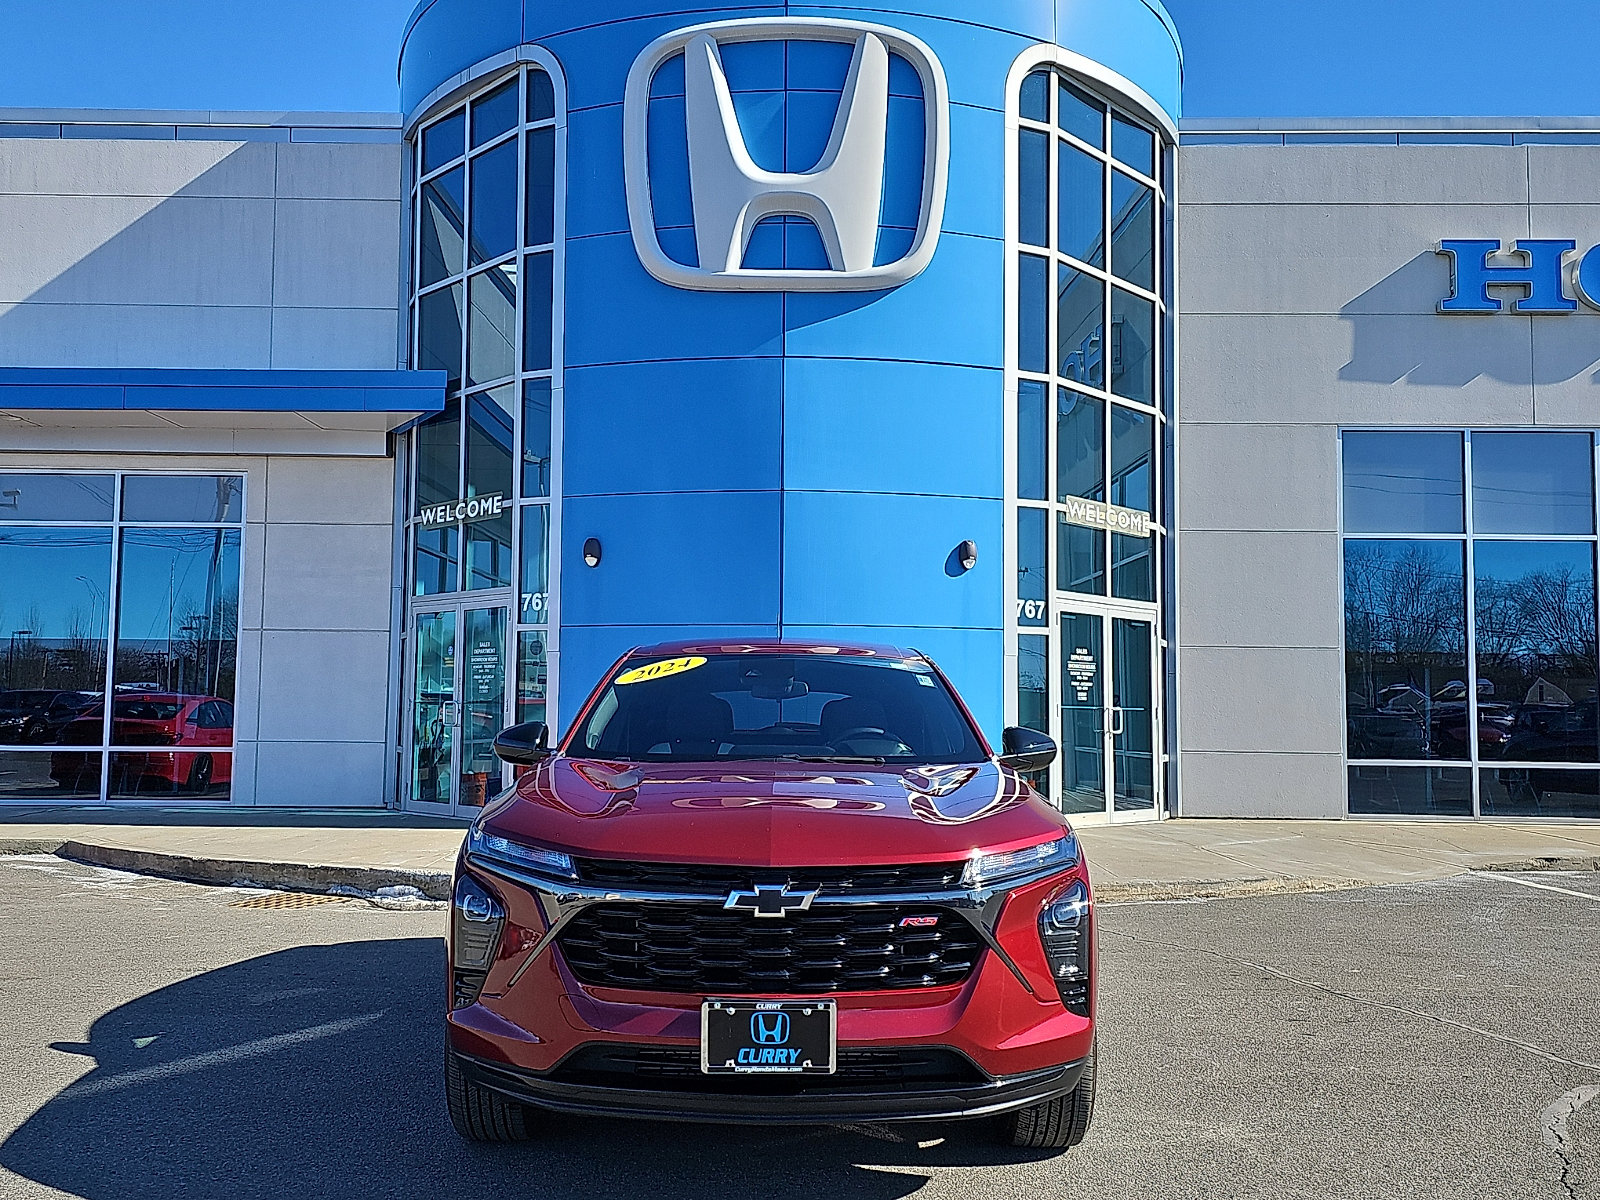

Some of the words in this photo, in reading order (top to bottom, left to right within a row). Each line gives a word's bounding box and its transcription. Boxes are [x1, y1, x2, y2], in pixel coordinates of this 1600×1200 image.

[420, 496, 503, 526] WELCOME
[1067, 499, 1150, 534] WELCOME
[1017, 599, 1046, 620] 767
[631, 658, 692, 682] 2024
[898, 916, 939, 927] RS
[737, 1048, 802, 1064] CURRY
